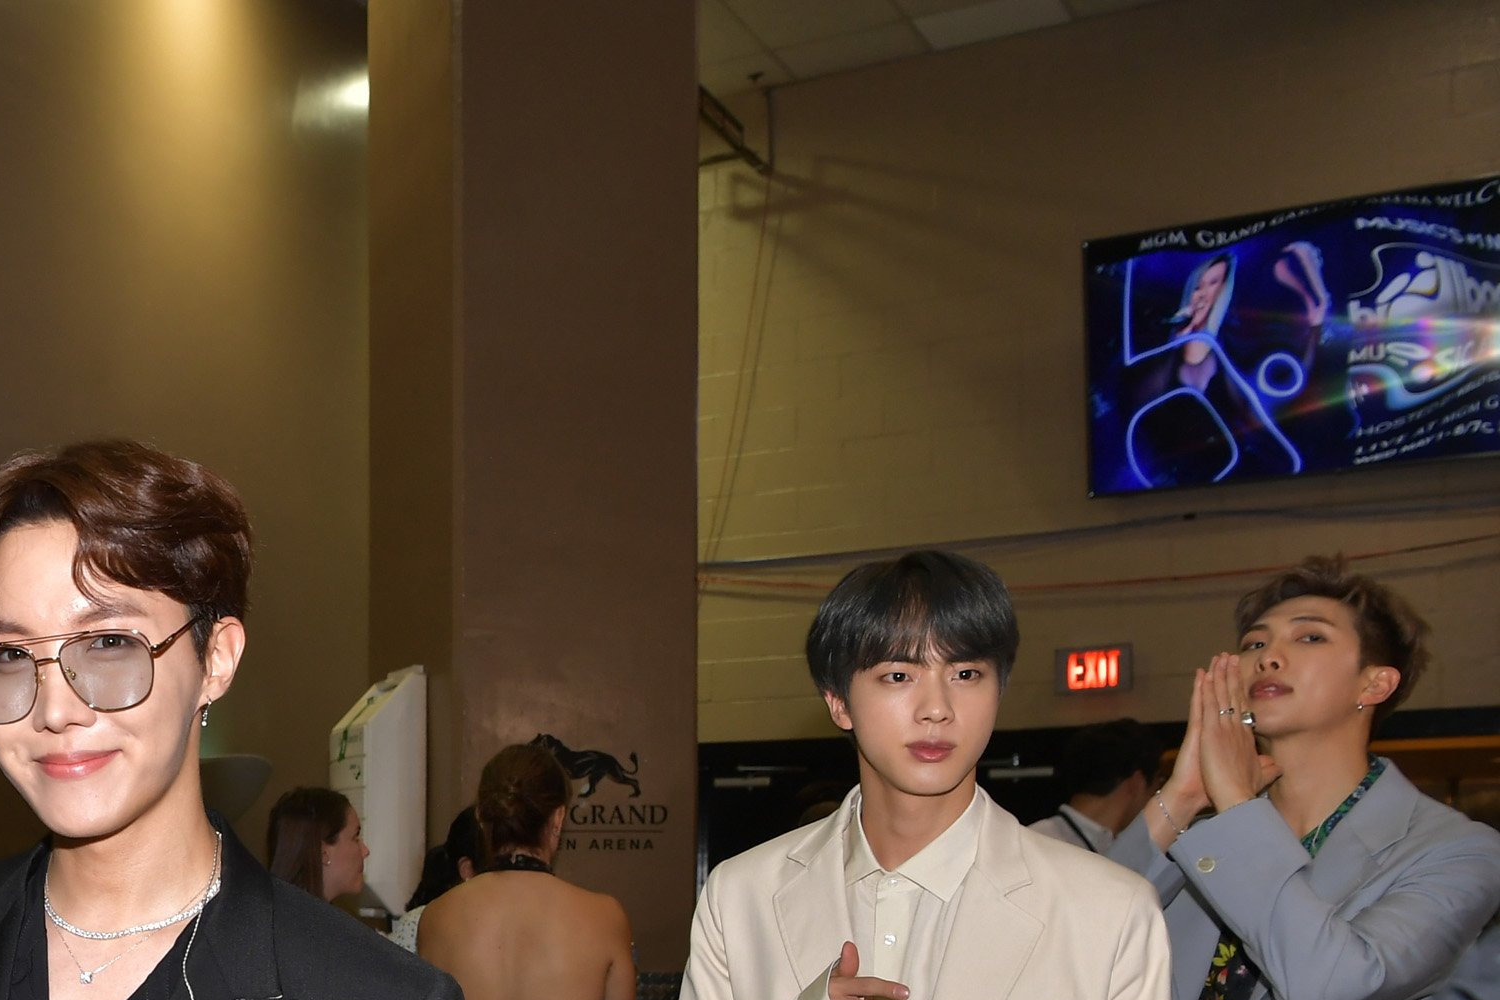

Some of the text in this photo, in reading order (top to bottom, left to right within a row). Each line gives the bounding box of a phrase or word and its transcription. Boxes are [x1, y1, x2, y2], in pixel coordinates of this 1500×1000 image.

[1067, 650, 1120, 690] EXIT
[569, 804, 668, 825] GRAND
[589, 838, 654, 850] ARENA
